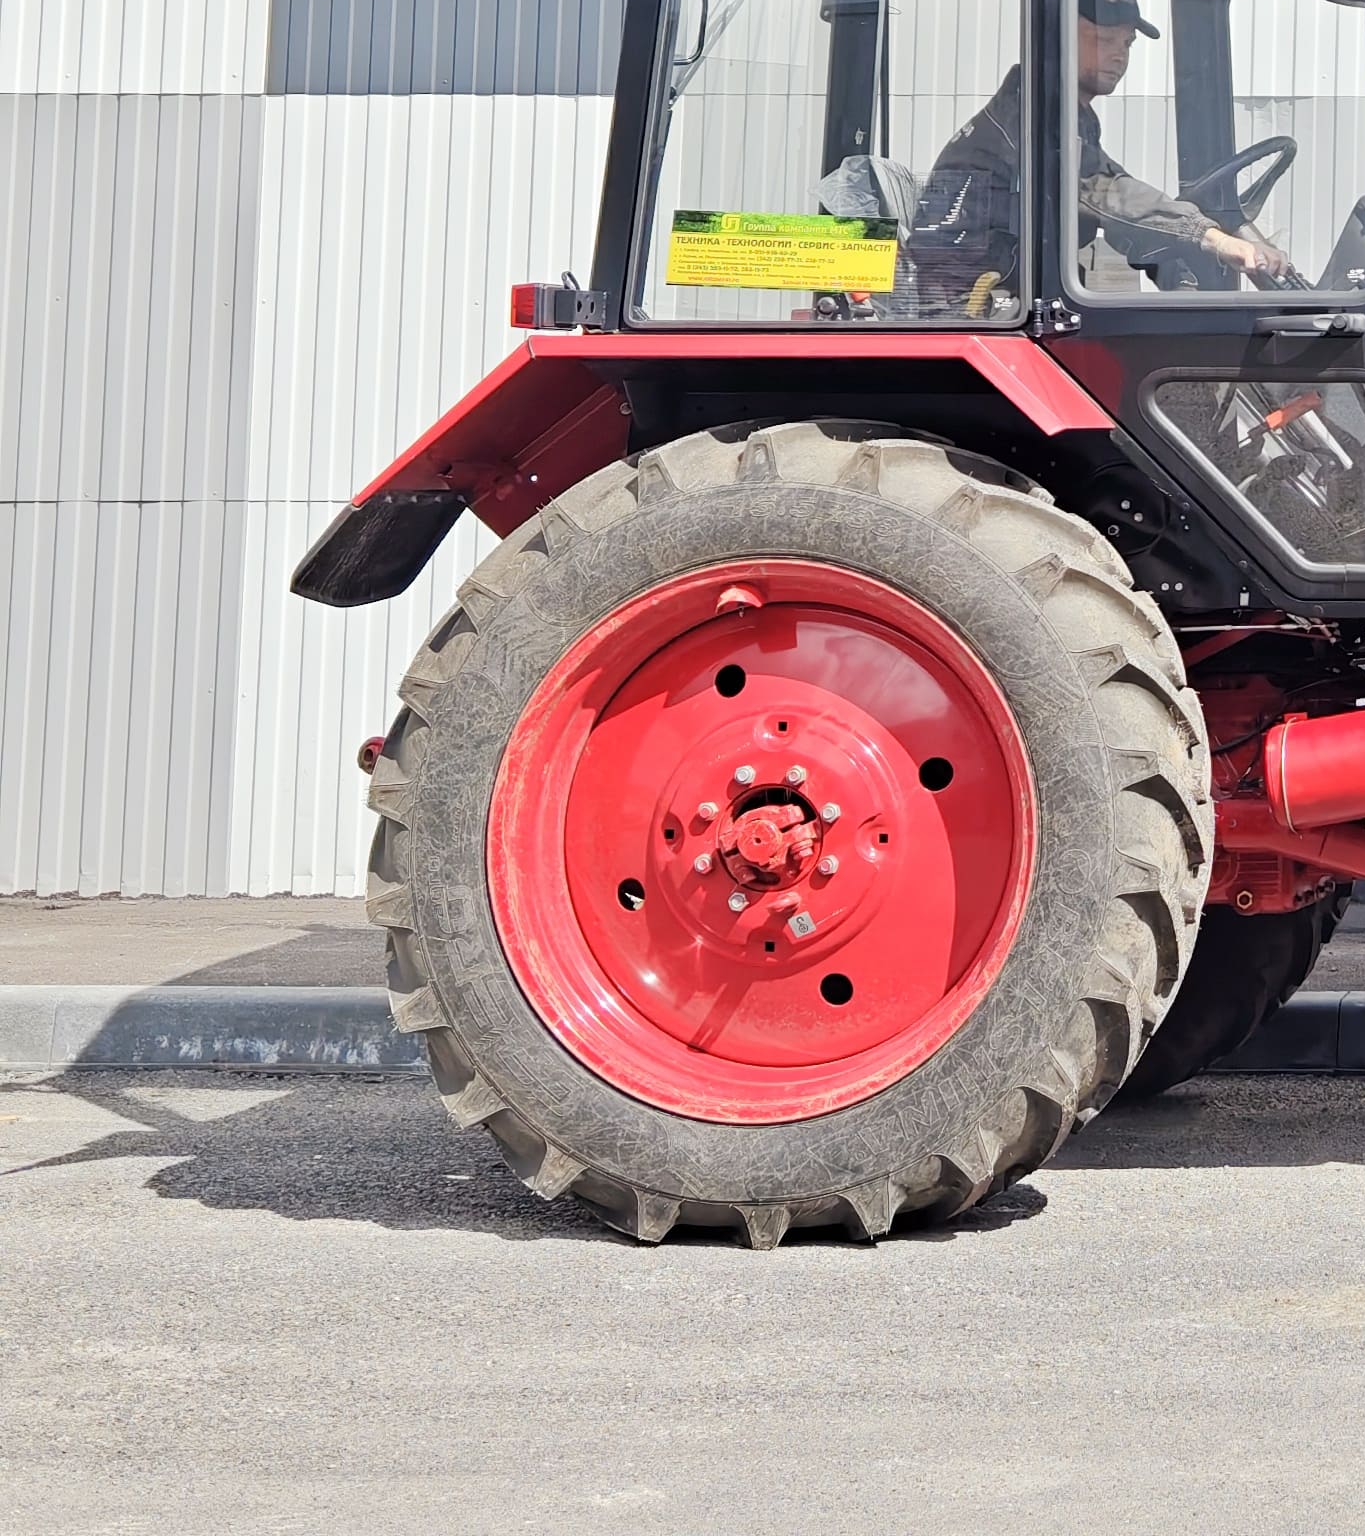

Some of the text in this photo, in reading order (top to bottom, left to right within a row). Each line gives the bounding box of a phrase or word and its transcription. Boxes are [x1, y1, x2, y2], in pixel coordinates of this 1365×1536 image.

[743, 223, 776, 233] Группа
[676, 236, 891, 252] ТЕХНИКА ТЕХНОЛОГИИ СЕРВИС ЗАПЧАСТИ
